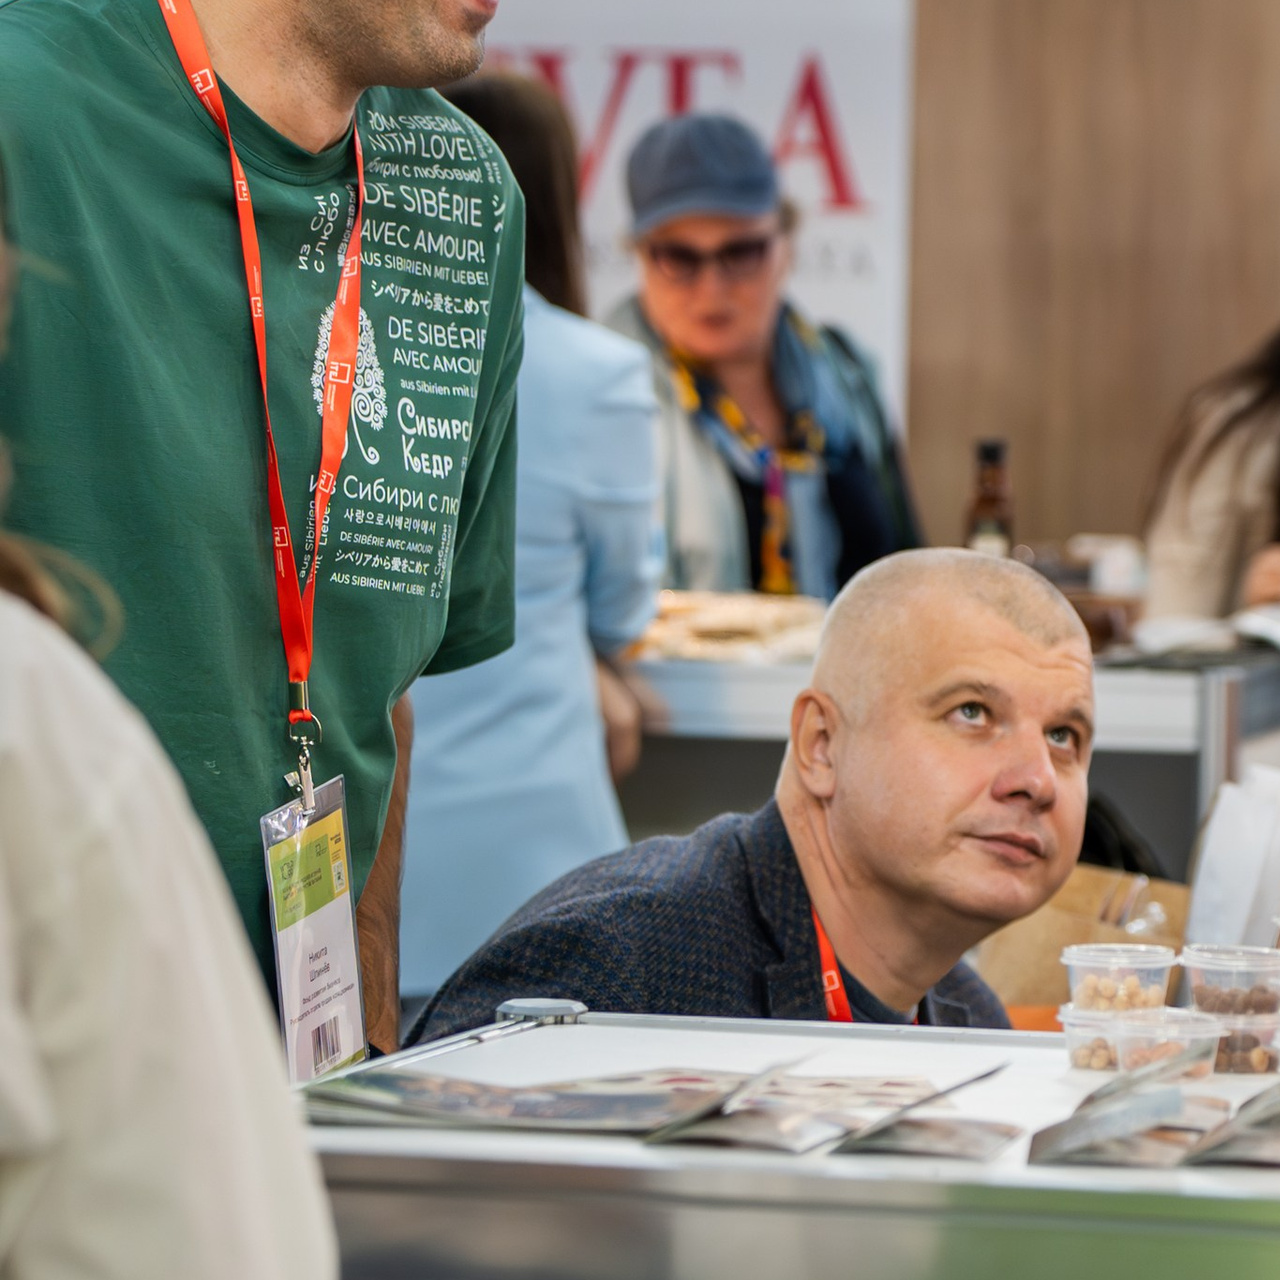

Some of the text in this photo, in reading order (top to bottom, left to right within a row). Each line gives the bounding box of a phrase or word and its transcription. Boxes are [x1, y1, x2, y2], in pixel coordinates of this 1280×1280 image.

[420, 133, 478, 162] LOVE!
[402, 164, 412, 178] с
[413, 163, 483, 184] любовью!
[363, 182, 396, 209] DE
[400, 184, 483, 228] SIBÉRIE
[360, 218, 486, 264] AVEC AMOUR!
[360, 251, 490, 287] AUS SIBIRIEN MIT LIEBE!
[388, 315, 414, 342] DE
[393, 347, 431, 371] AVEC
[400, 379, 416, 392] aus
[416, 380, 452, 397] Sibirien
[452, 385, 470, 400] mit
[343, 474, 424, 513] Сибири
[428, 493, 438, 512] с
[340, 531, 434, 556] DE SIBÉRIE AVEC AMOUR!
[299, 553, 311, 578] aus
[330, 572, 350, 585] AUS
[351, 575, 391, 591] SIBIRIEN
[391, 581, 406, 593] MIT
